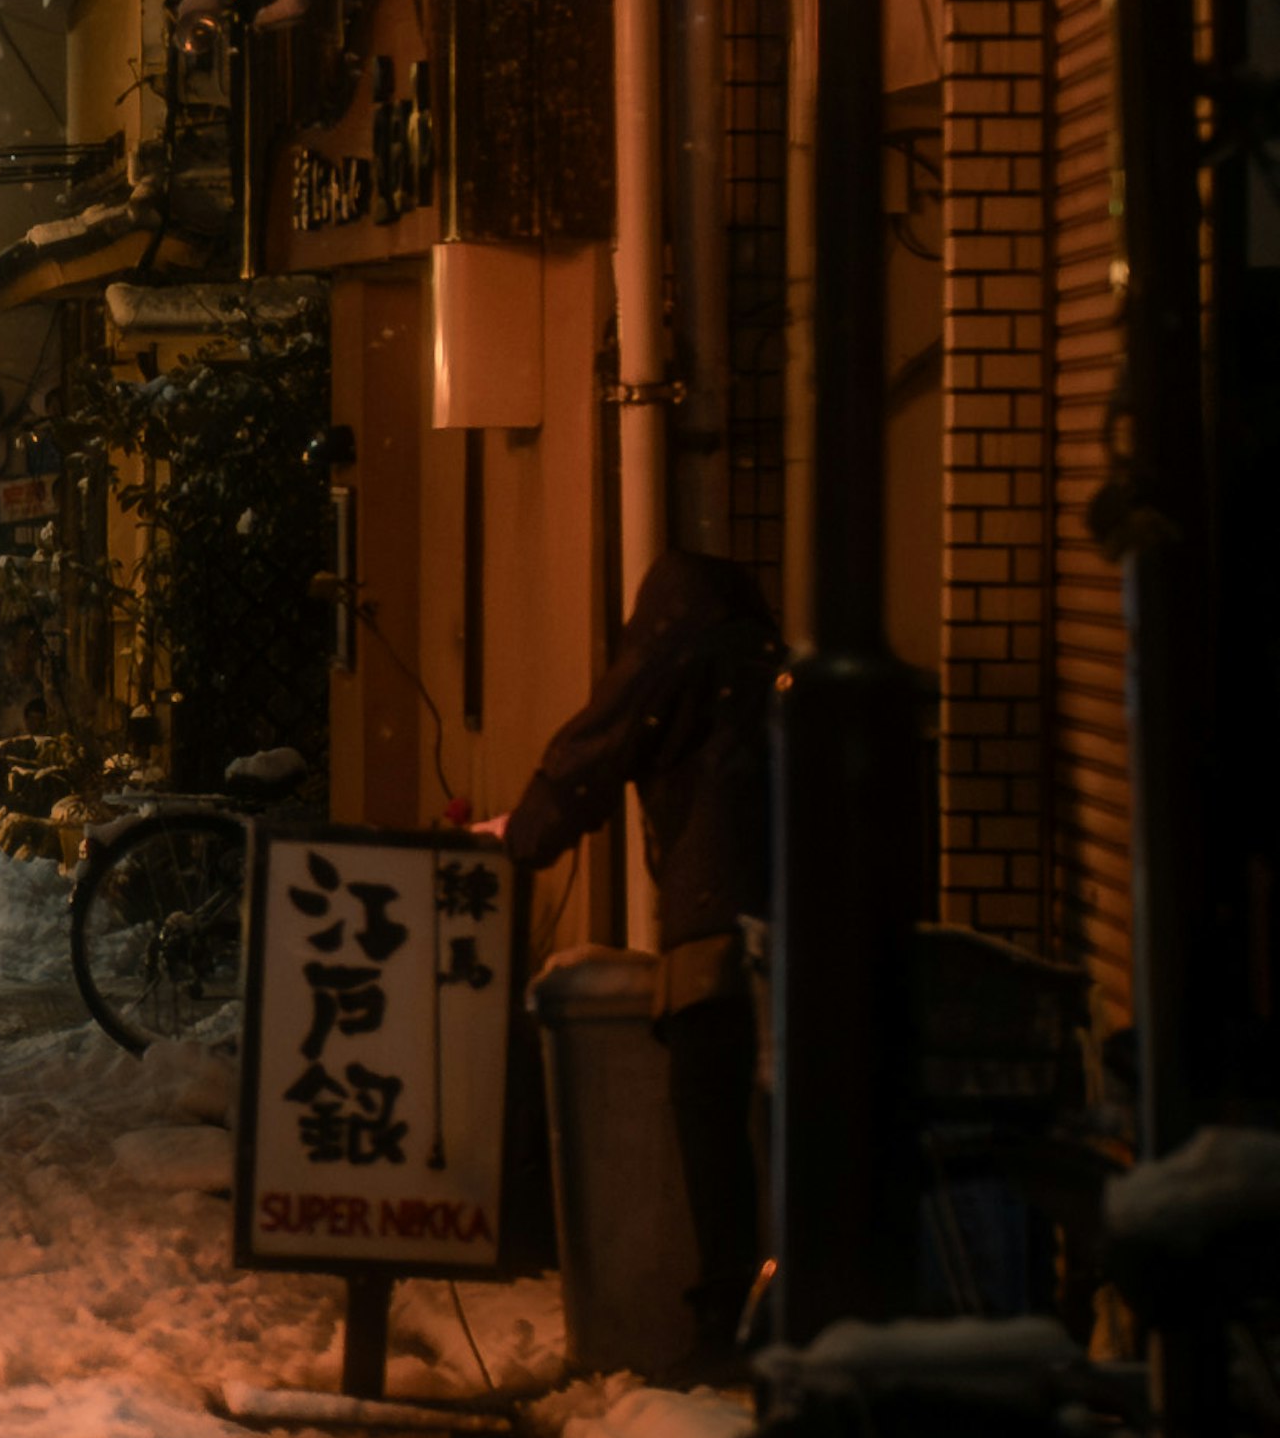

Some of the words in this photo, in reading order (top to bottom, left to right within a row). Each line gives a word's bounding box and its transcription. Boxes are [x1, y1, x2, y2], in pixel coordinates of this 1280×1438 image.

[283, 851, 410, 1165] 江戸銀
[259, 1192, 372, 1239] SUPER
[379, 1198, 494, 1246] NIKKA
